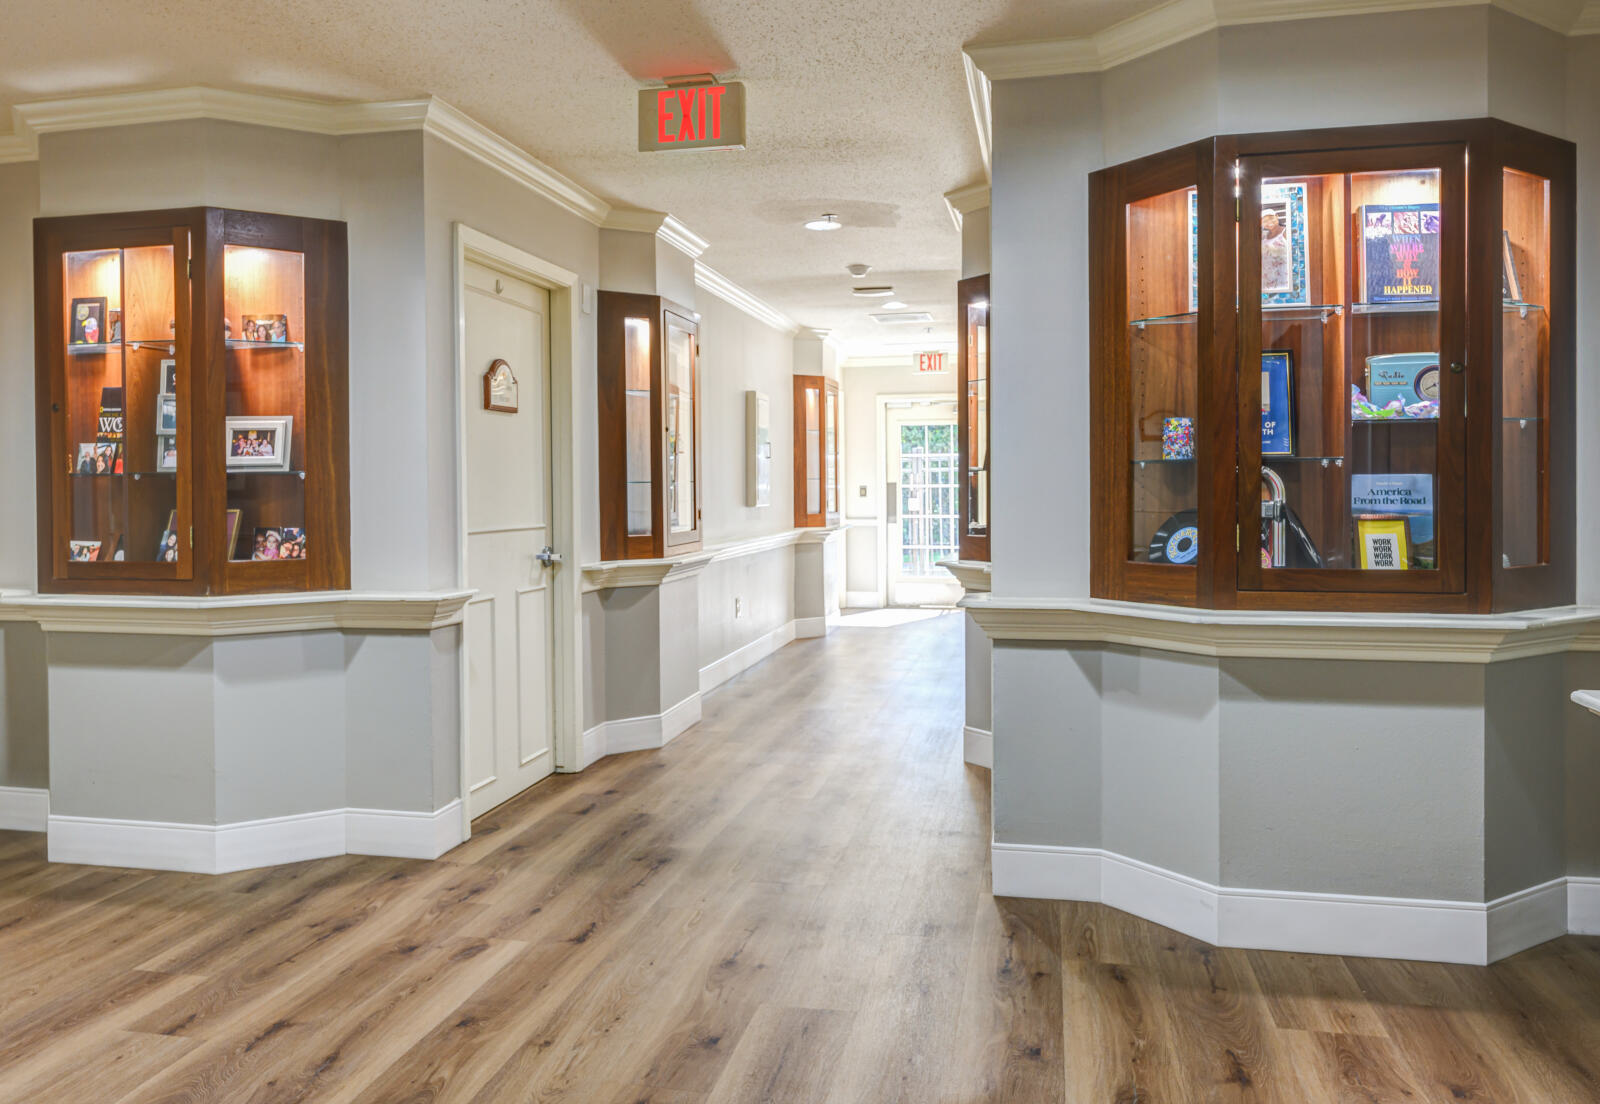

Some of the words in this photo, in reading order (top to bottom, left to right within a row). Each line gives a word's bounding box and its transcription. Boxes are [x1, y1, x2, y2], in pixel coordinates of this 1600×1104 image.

[658, 86, 726, 143] EXIT
[1391, 234, 1422, 244] WHEN
[1389, 243, 1424, 254] WHERE
[1395, 252, 1418, 262] WHY
[1396, 269, 1419, 278] HOW
[1383, 285, 1433, 295] HAPPENED
[919, 353, 944, 371] EXIT
[1367, 488, 1412, 496] America
[1353, 497, 1380, 505] From
[1382, 497, 1399, 505] the
[1400, 497, 1426, 505] Road
[1372, 538, 1392, 546] WORK
[1374, 552, 1393, 560] WORK
